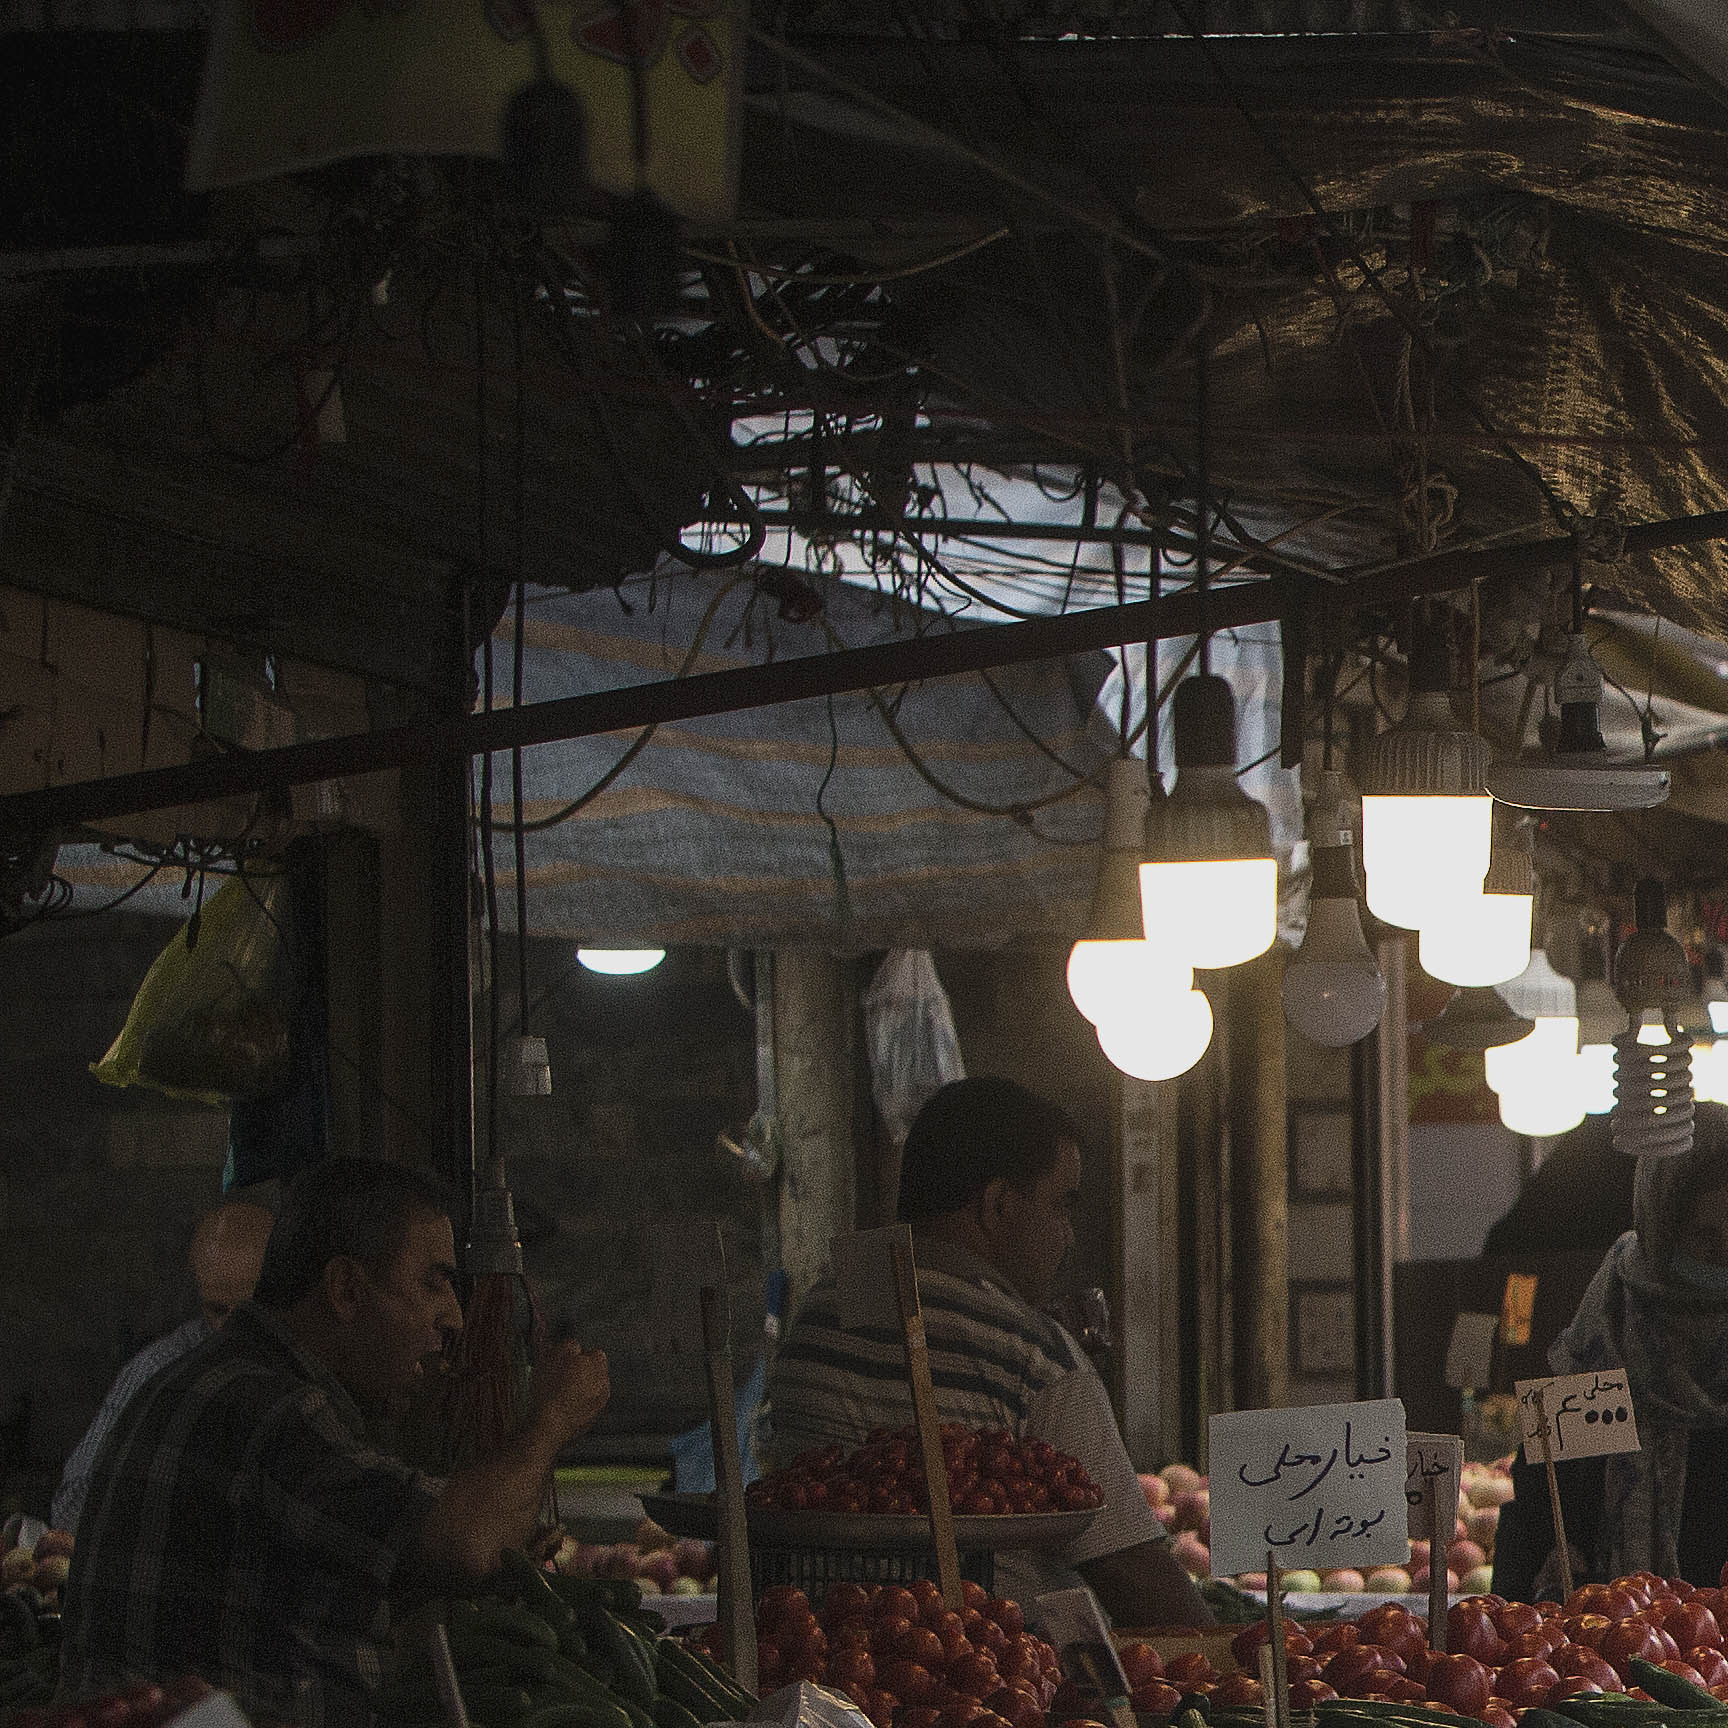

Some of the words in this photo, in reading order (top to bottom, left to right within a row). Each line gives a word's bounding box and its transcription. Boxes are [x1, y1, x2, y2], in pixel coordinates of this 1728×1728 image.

[1584, 1375, 1624, 1400] محلی
[1239, 1443, 1322, 1487] محلی
[1287, 1421, 1392, 1501] خیار
[1329, 1509, 1386, 1541] بوته
